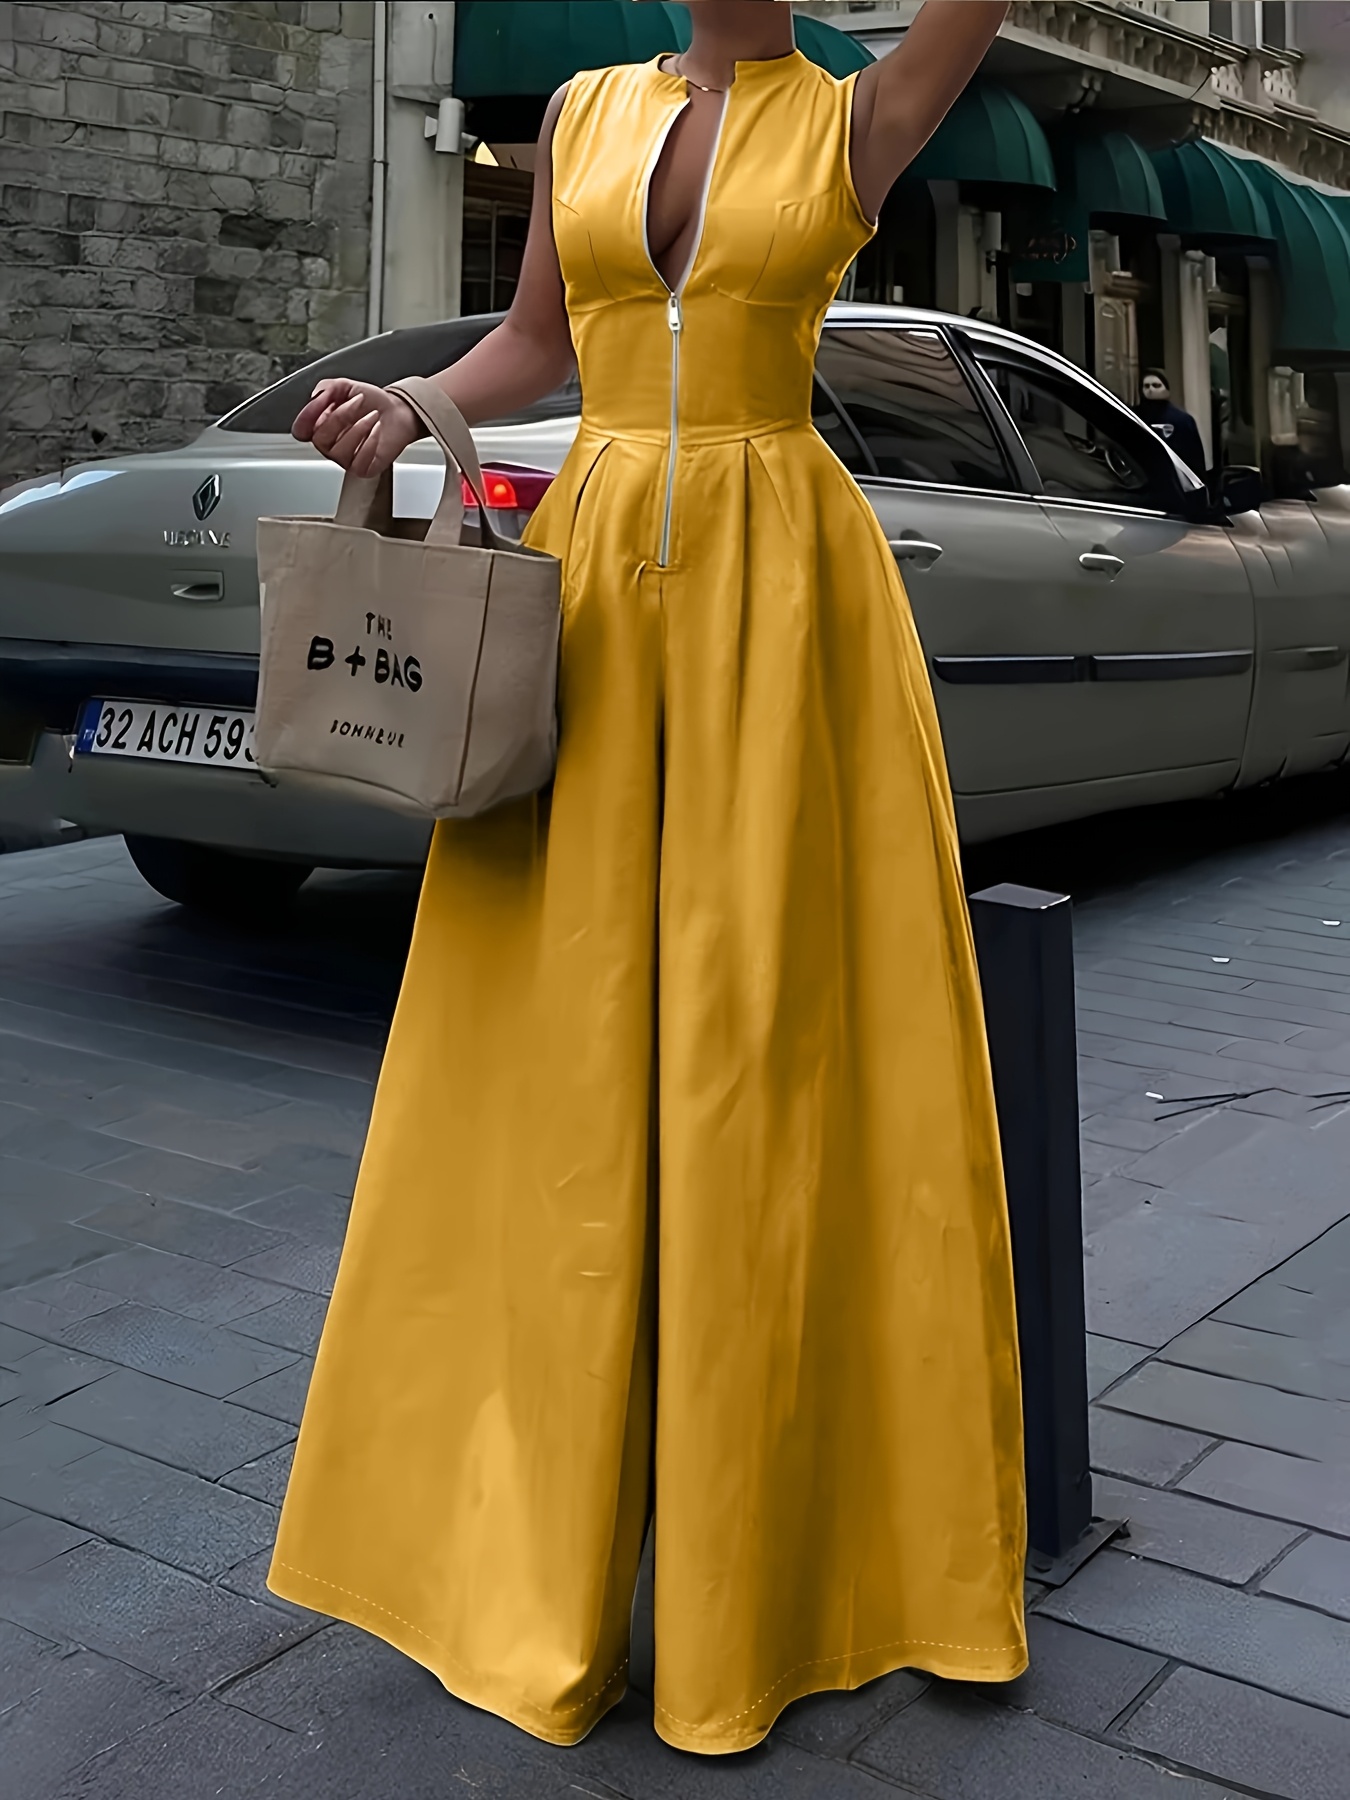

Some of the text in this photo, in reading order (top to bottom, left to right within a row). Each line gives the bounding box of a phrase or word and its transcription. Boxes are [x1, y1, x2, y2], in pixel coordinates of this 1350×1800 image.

[306, 635, 335, 671] B
[374, 648, 423, 693] BAG
[96, 707, 134, 750] 32
[136, 710, 200, 756] ACH
